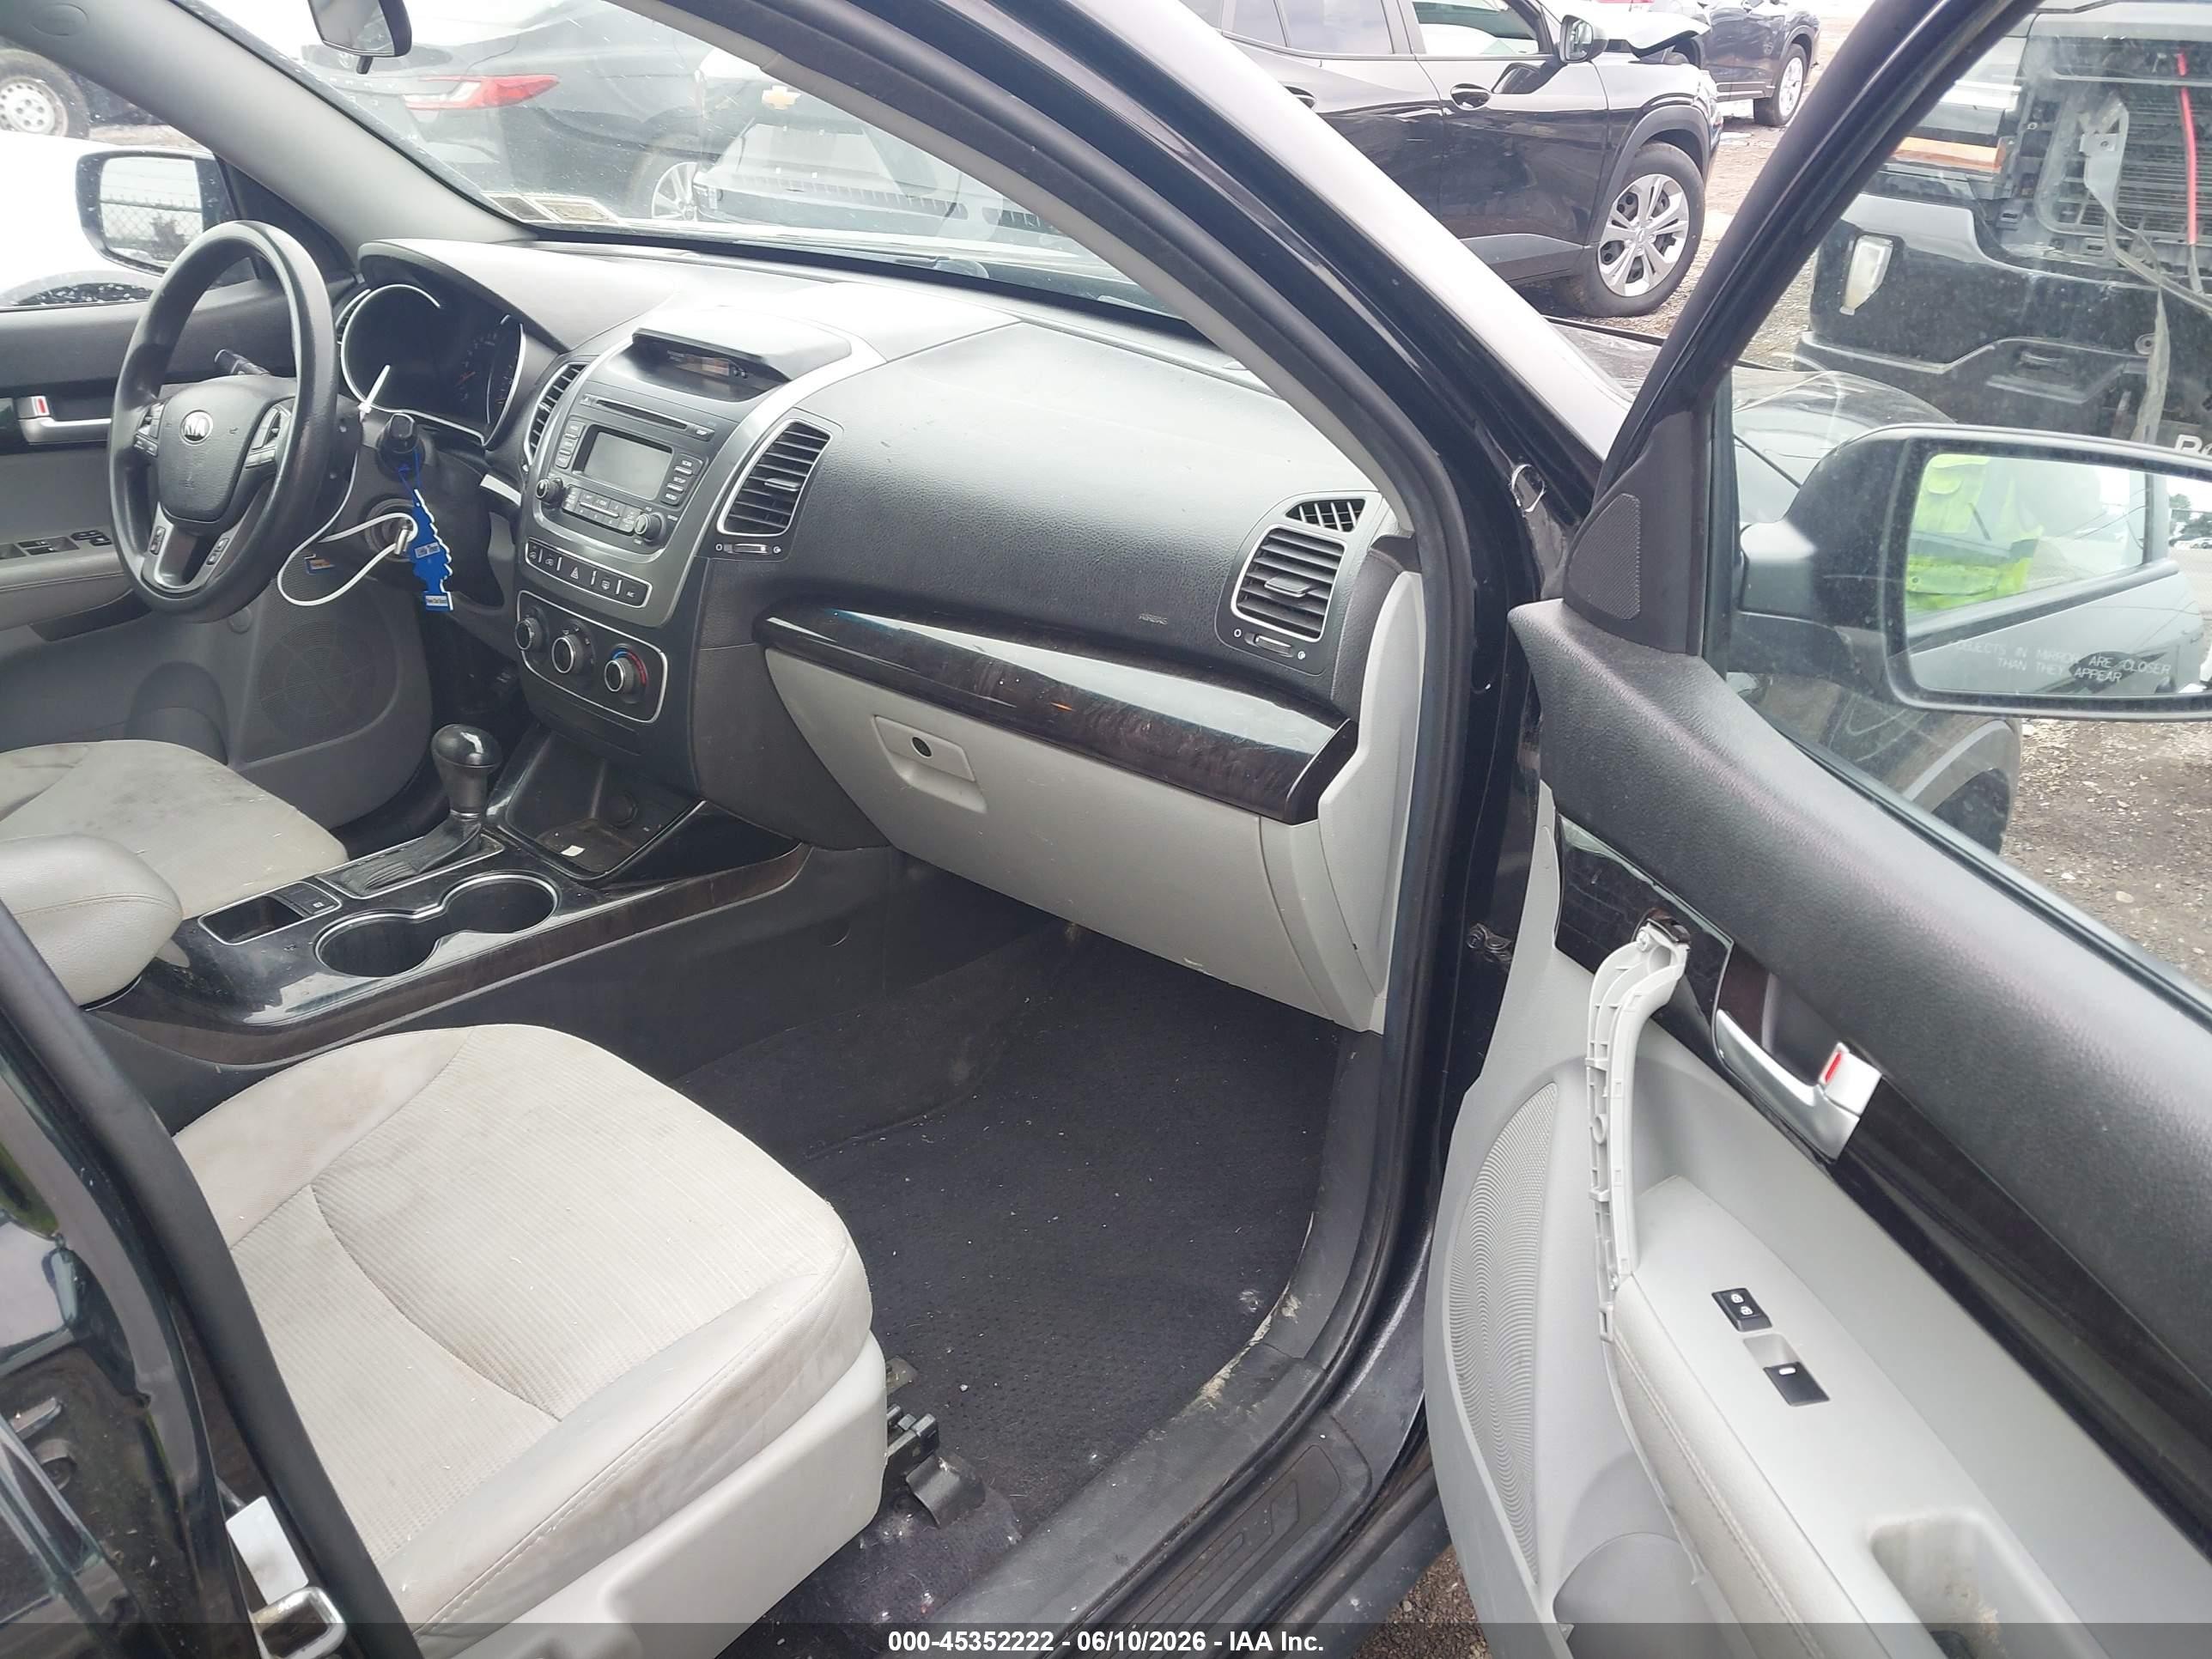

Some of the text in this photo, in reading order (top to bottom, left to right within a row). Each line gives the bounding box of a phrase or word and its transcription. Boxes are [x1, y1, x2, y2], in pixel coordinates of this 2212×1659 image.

[1957, 641, 2172, 675] OBJECTS IN MIRROR ARE CLOSER
[1998, 657, 2123, 683] THAN THEY APPEAR
